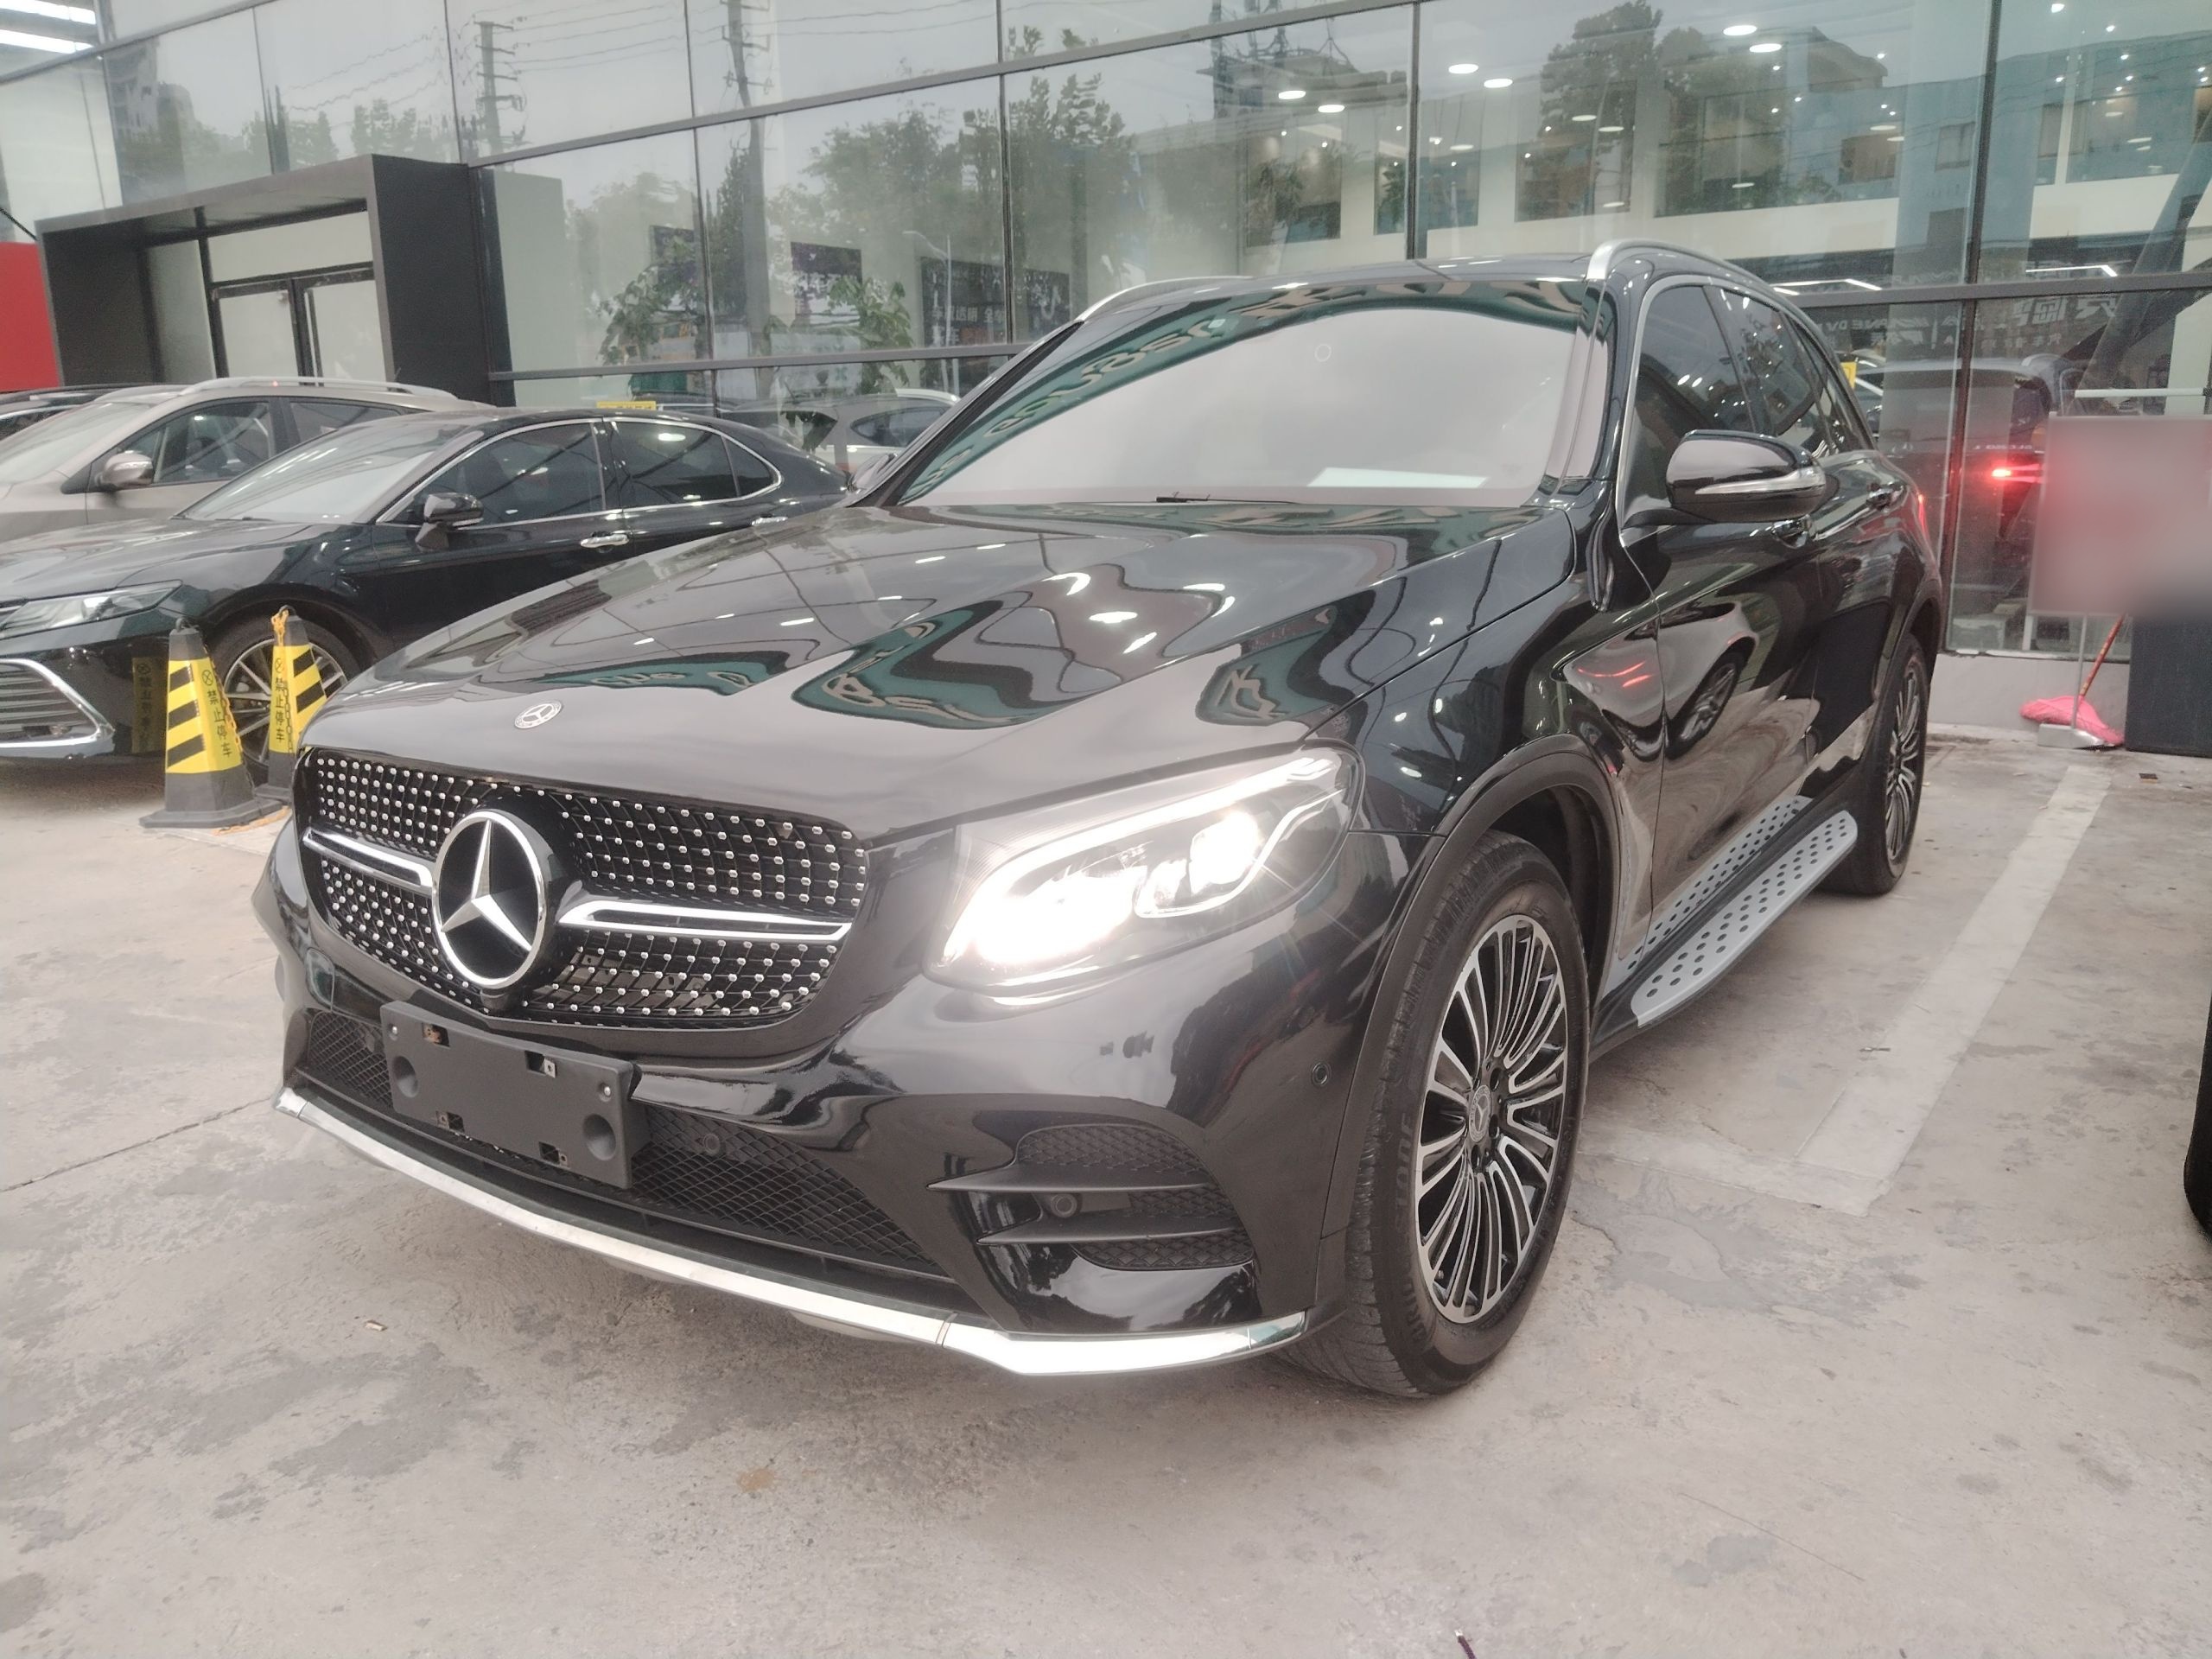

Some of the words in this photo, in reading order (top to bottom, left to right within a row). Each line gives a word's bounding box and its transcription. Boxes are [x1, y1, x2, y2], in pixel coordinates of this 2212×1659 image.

[207, 690, 232, 757] 禁止停车
[275, 677, 286, 741] 禁止停车
